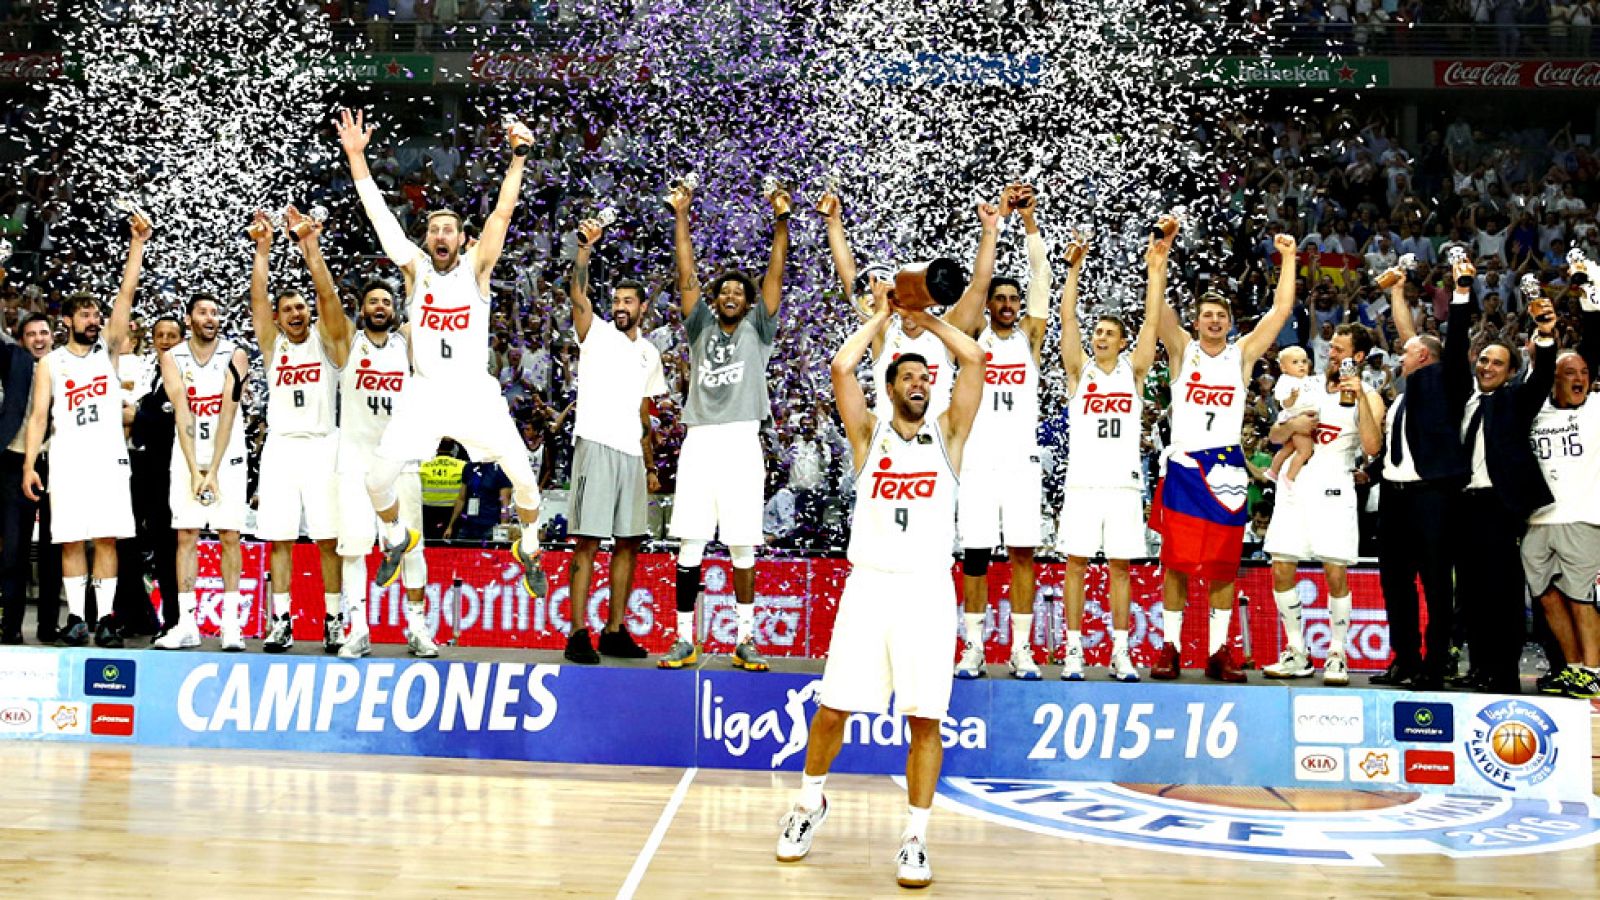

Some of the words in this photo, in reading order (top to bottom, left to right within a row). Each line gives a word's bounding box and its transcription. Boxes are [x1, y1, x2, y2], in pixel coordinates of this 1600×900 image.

[1239, 66, 1330, 81] Heineken
[420, 294, 470, 332] Teka
[440, 338, 452, 358] 6
[276, 355, 321, 387] Teka
[355, 358, 404, 392] Teka
[698, 360, 744, 388] Teka
[293, 389, 304, 408] 8
[994, 391, 1013, 411] 14
[1082, 382, 1133, 415] Teka
[1184, 371, 1236, 407] Teka
[77, 404, 98, 426] 23
[367, 396, 393, 416] 44
[200, 422, 210, 440] 5
[1098, 418, 1121, 439] 20
[1205, 411, 1216, 431] 7
[432, 468, 447, 478] 141
[871, 456, 938, 500] Teka
[894, 507, 908, 532] 9
[176, 662, 560, 734] CAMPEONES
[4, 711, 27, 721] KIA
[702, 679, 785, 757] liga
[842, 710, 987, 749] ndsa
[1027, 701, 1240, 760] 2015-16
[1307, 757, 1332, 769] KIA
[1472, 729, 1512, 783] PLAYOFF
[970, 781, 1284, 842] AYOFF
[1445, 816, 1582, 846] 2016
